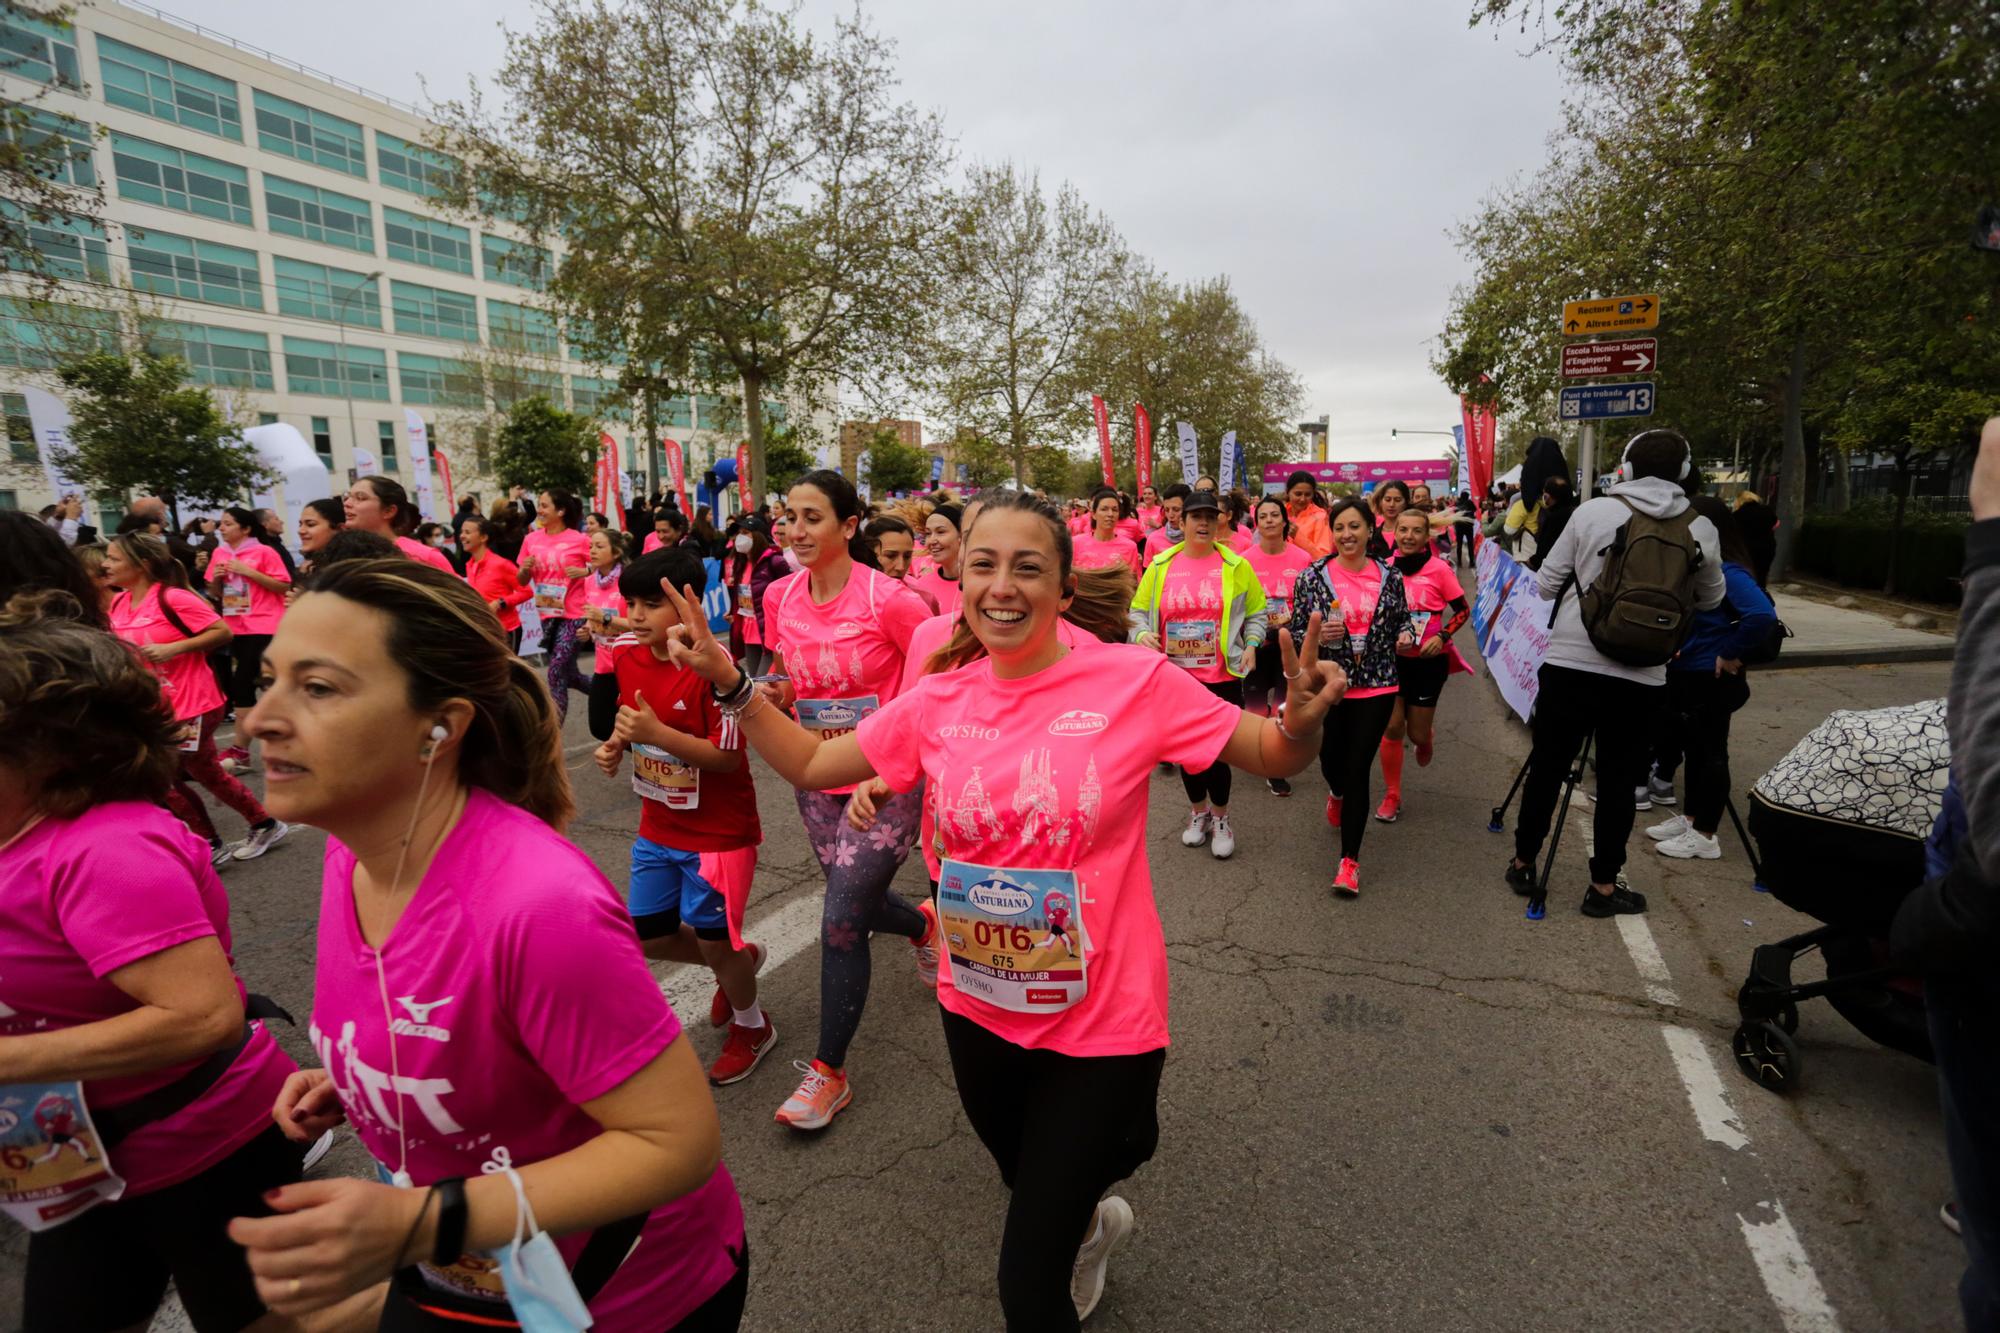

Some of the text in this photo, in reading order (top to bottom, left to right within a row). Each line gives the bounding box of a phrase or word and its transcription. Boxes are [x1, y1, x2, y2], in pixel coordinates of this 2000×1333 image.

[1586, 317, 1646, 329] Altres centres
[1566, 342, 1655, 356] Escola Tècnica Superior
[1566, 356, 1611, 366] d'Enginyeria
[1626, 388, 1650, 411] 13
[1178, 640, 1200, 648] 016
[940, 725, 1000, 741] OYSHO
[645, 757, 671, 775] 016
[972, 890, 1029, 909] ASTURIANA
[974, 920, 1031, 951] 016
[992, 954, 1014, 968] 675
[969, 961, 1050, 981] CARRERA DE LA MUJER
[961, 974, 993, 994] OYSHO
